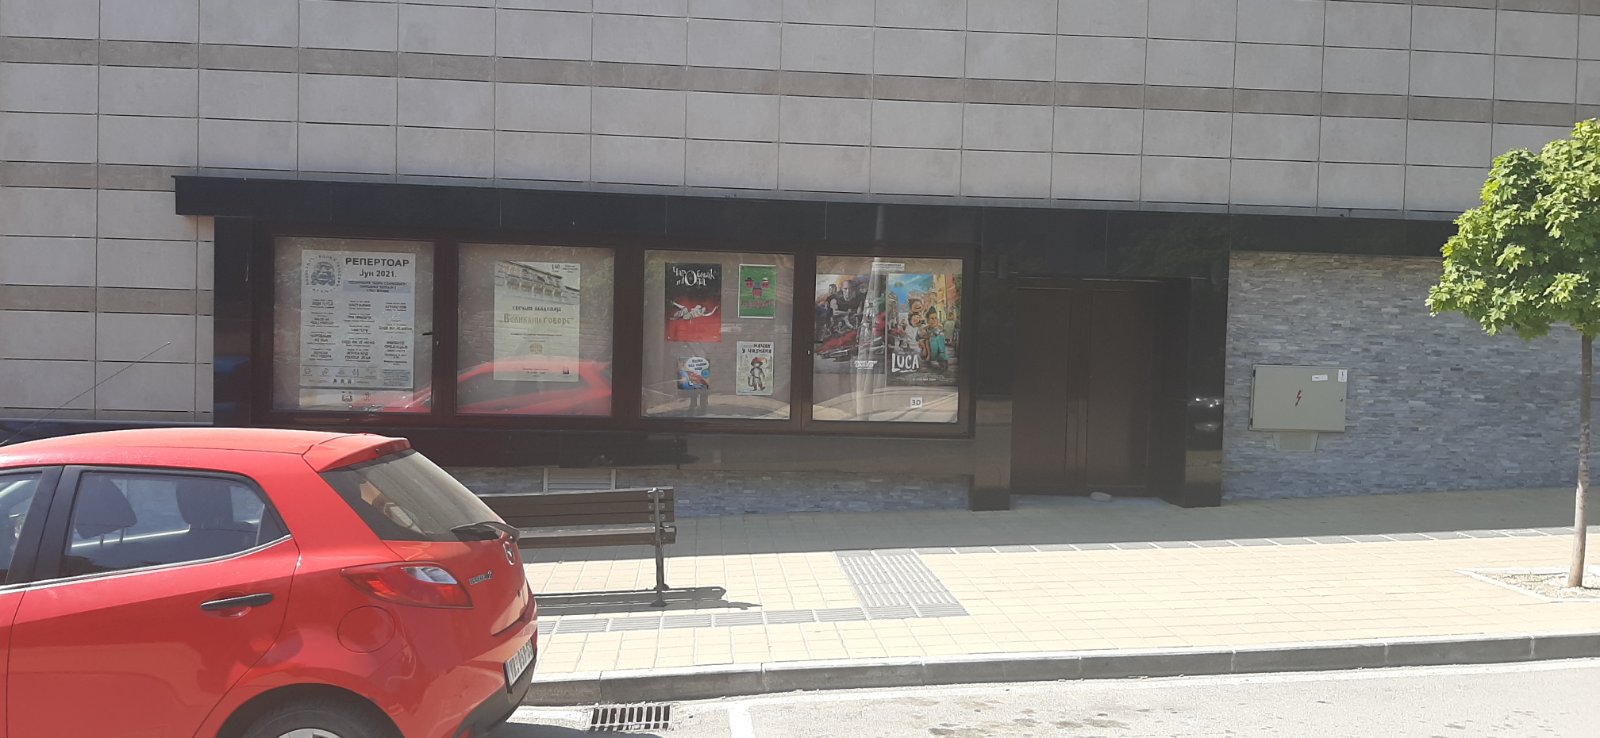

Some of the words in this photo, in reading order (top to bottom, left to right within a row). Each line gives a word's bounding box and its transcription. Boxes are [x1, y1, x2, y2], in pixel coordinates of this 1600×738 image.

[345, 257, 410, 267] РЕПЕРТОАР
[359, 270, 374, 278] Јун
[376, 270, 397, 278] 2021.
[891, 352, 920, 373] LUCA
